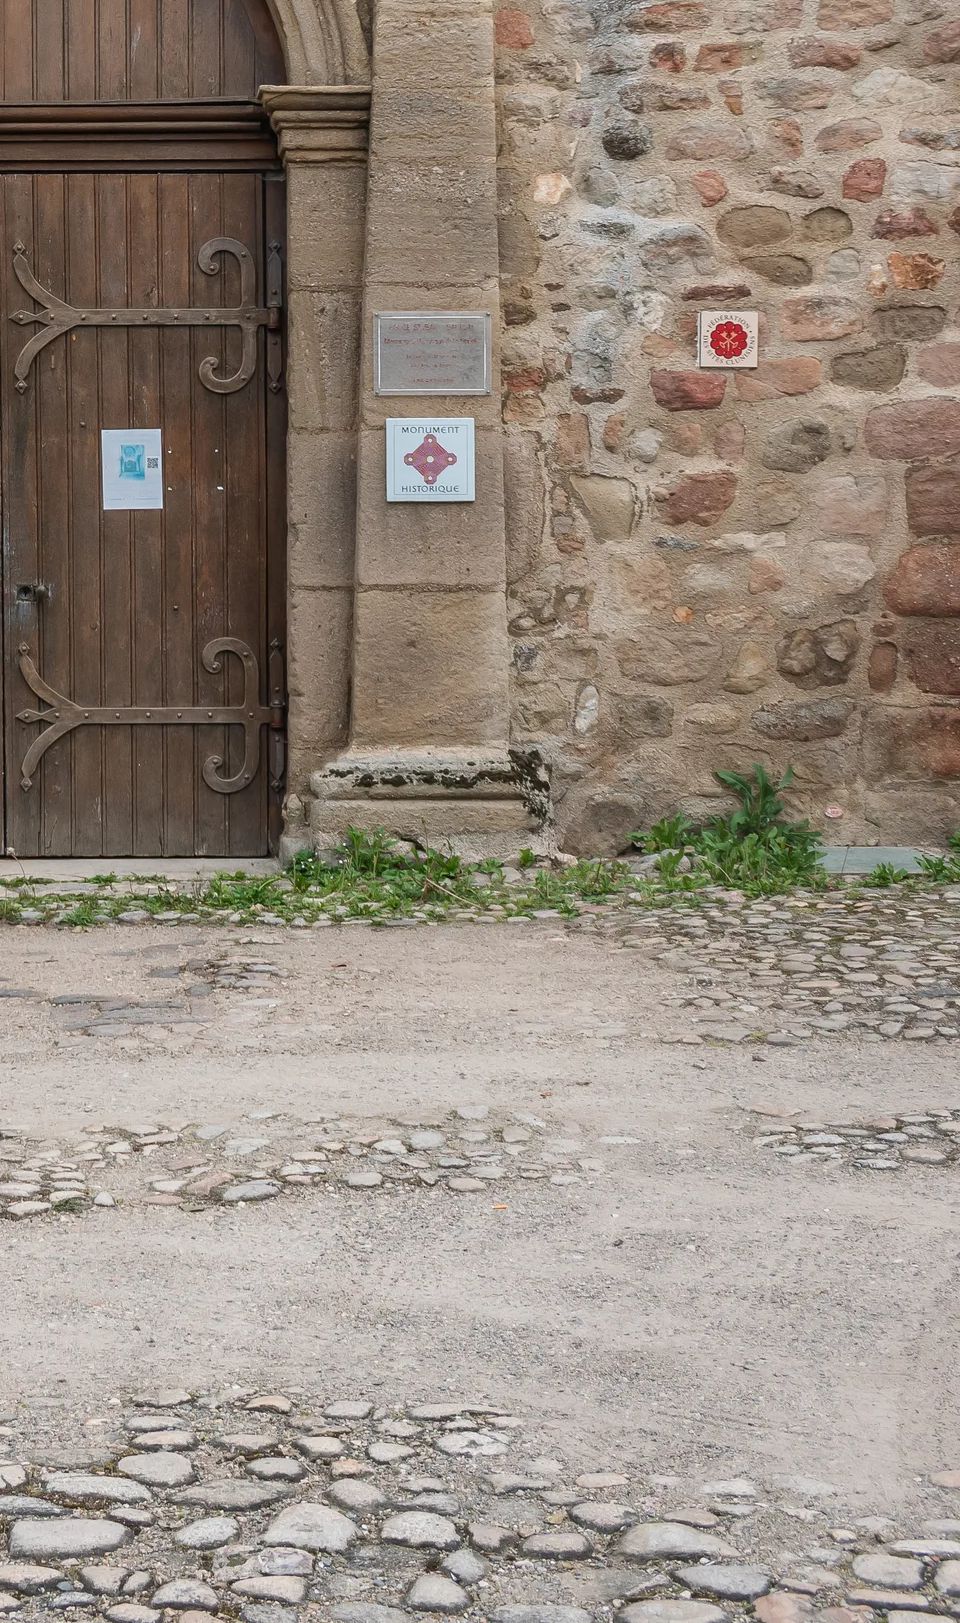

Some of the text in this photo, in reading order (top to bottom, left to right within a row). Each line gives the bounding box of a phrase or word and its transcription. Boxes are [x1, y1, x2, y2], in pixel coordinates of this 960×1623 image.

[706, 349, 724, 364] SITES
[725, 335, 756, 365] CLUNISIENS
[401, 426, 460, 434] MONUMENT
[401, 485, 460, 493] HISTORIQUE
